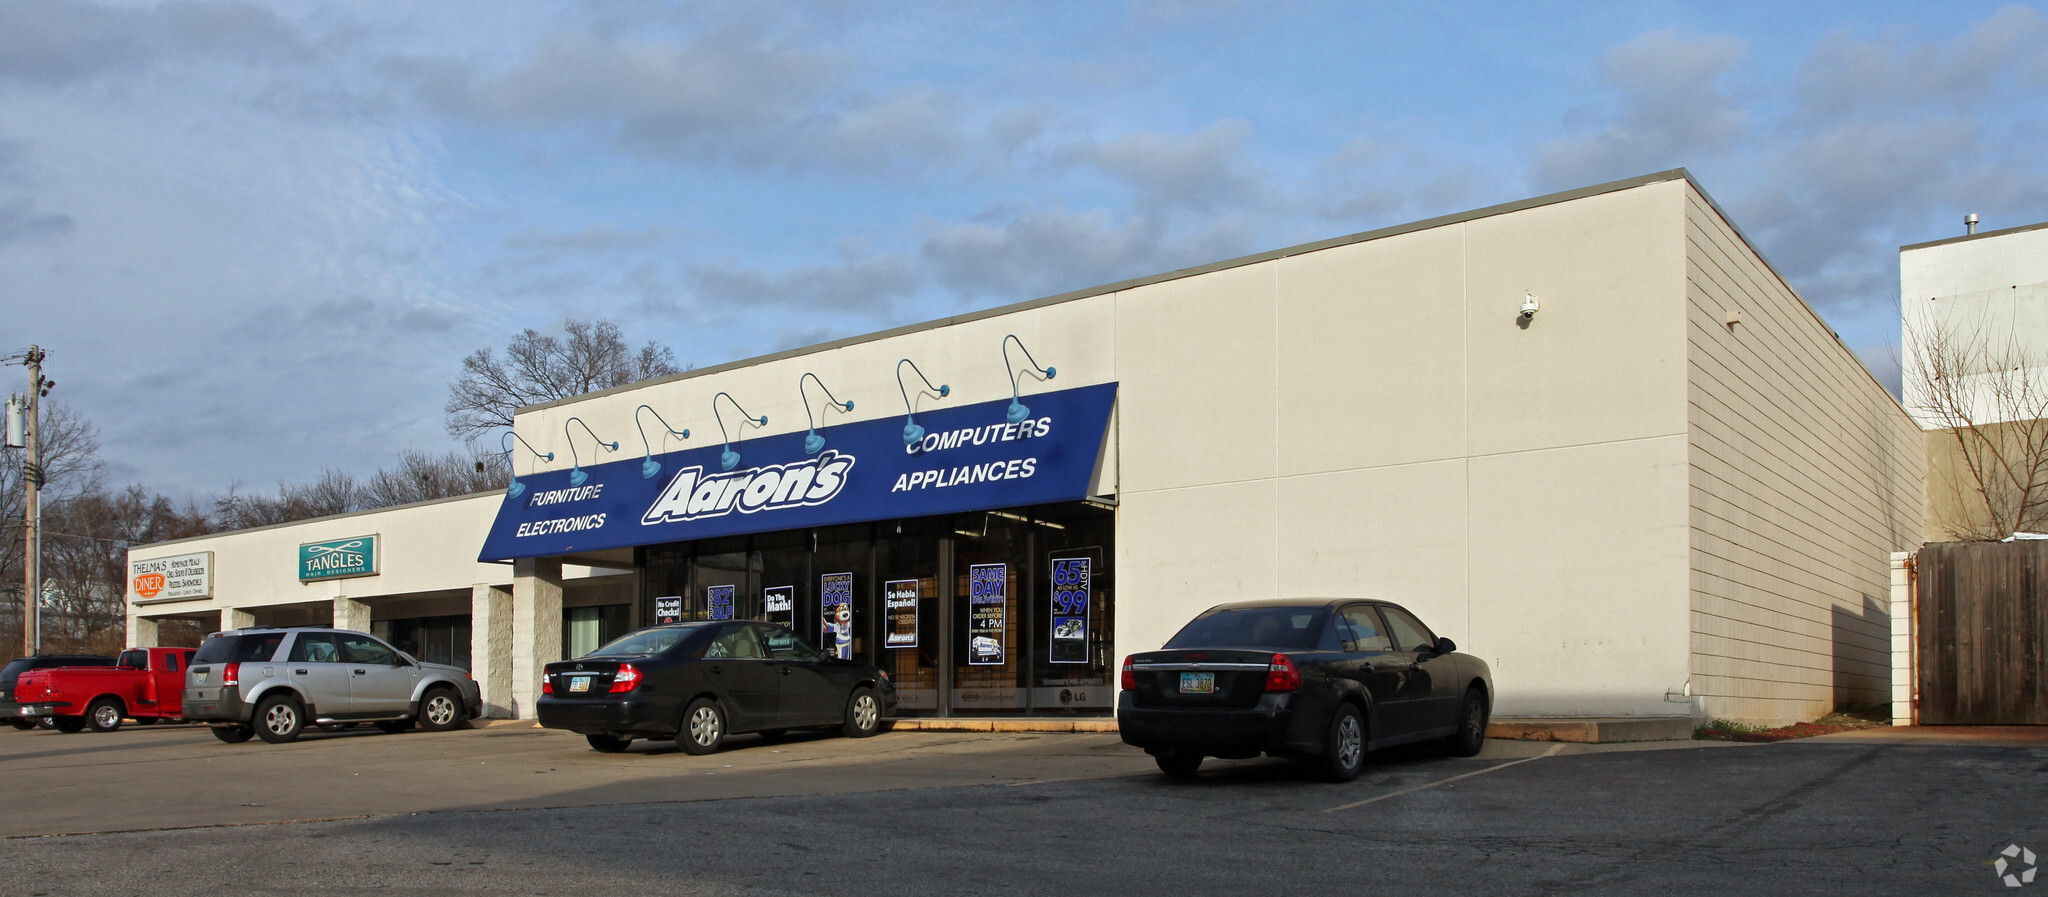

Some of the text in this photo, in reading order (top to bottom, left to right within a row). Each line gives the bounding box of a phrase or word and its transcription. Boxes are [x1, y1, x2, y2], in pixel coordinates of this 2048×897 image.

[906, 416, 1052, 455] COMPUTERS
[891, 457, 1037, 493] APPLIANCES
[642, 451, 854, 523] Aaron's
[529, 483, 604, 507] FURNITURE
[516, 513, 607, 538] ELECTRONICS
[133, 560, 167, 574] THELMA'S
[305, 552, 364, 571] TANGLES
[326, 566, 366, 575] DESIGNERS
[973, 567, 1004, 581] SAME
[135, 576, 163, 592] DINER
[1080, 566, 1088, 590] HDTV
[824, 581, 849, 592] LUCKY
[973, 580, 1003, 597] DAY
[775, 593, 785, 601] The
[824, 591, 850, 606] DOG
[888, 590, 915, 599] Se Habla
[664, 600, 679, 608] Credit
[767, 600, 791, 612] Math!
[887, 599, 916, 609] Español!
[657, 608, 679, 617] Checks!
[713, 605, 733, 619] DLP
[980, 619, 1003, 629] 4 PM
[888, 633, 915, 643] Aaron's
[1074, 693, 1086, 701] LG
